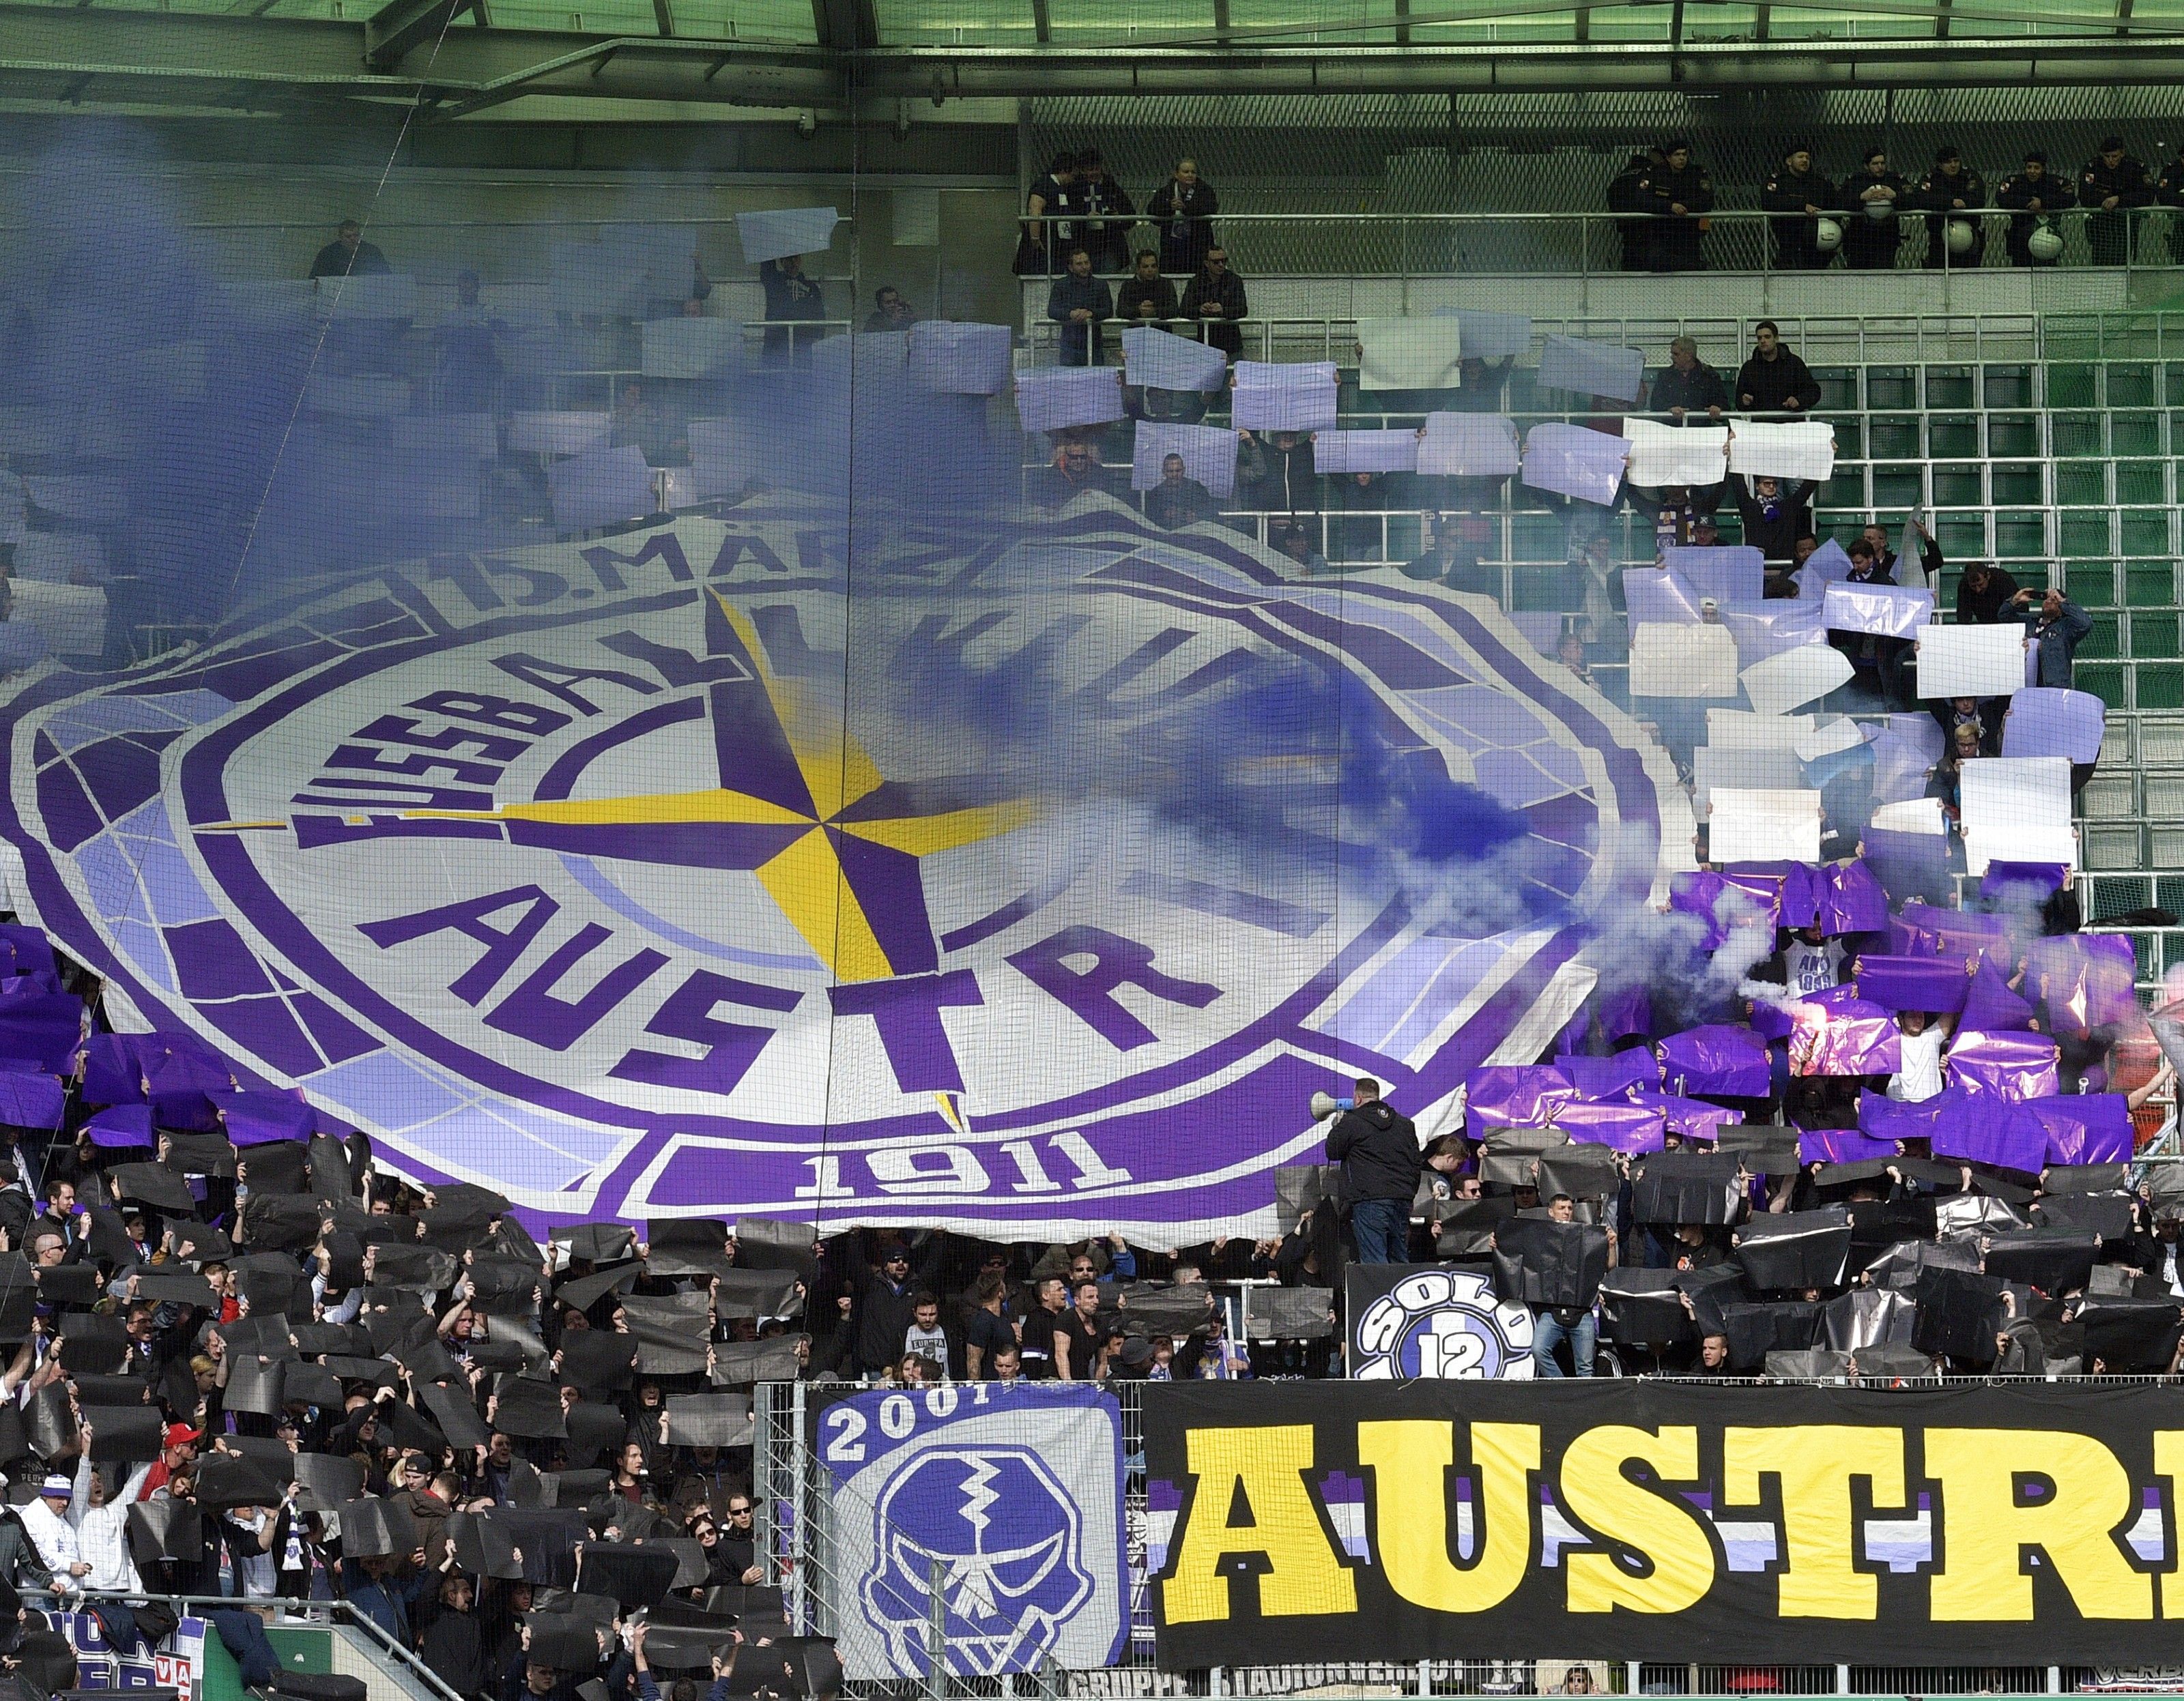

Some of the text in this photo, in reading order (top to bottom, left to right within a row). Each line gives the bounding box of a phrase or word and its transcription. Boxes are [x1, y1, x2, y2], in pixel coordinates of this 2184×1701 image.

[794, 1131, 1132, 1198] 1911
[1360, 1273, 1535, 1353] SOLO
[1418, 1332, 1484, 1378] 12
[827, 1384, 990, 1462] 2001
